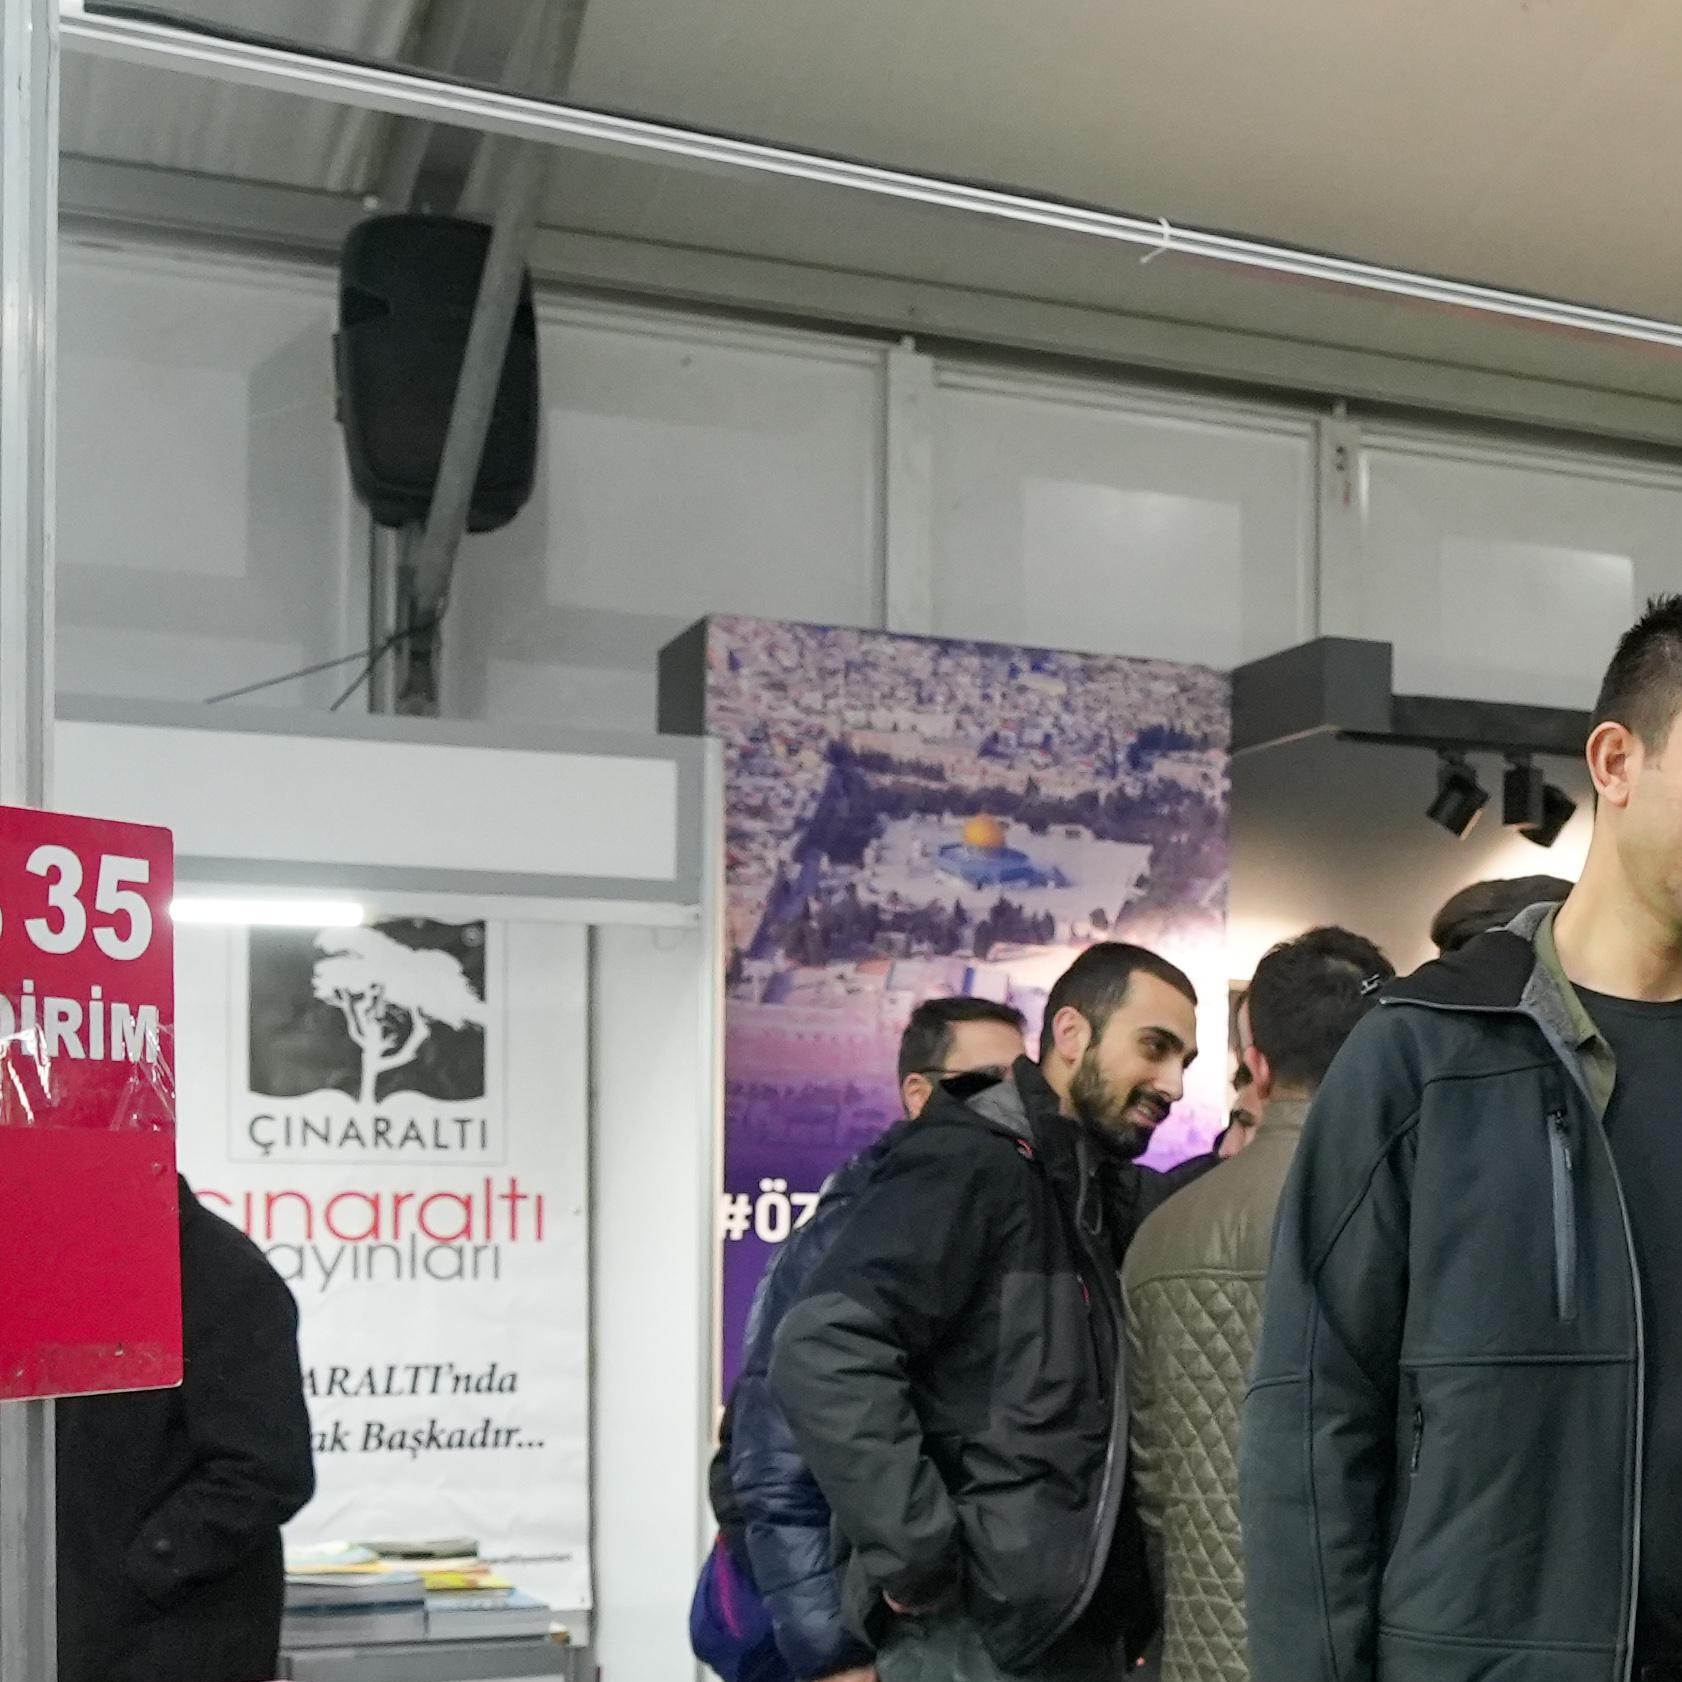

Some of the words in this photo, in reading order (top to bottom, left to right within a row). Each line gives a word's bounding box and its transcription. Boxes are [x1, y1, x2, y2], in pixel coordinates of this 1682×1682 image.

[24, 844, 153, 962] 35
[249, 1114, 488, 1158] ÇINARALTI
[360, 1422, 546, 1460] Başkadır...
